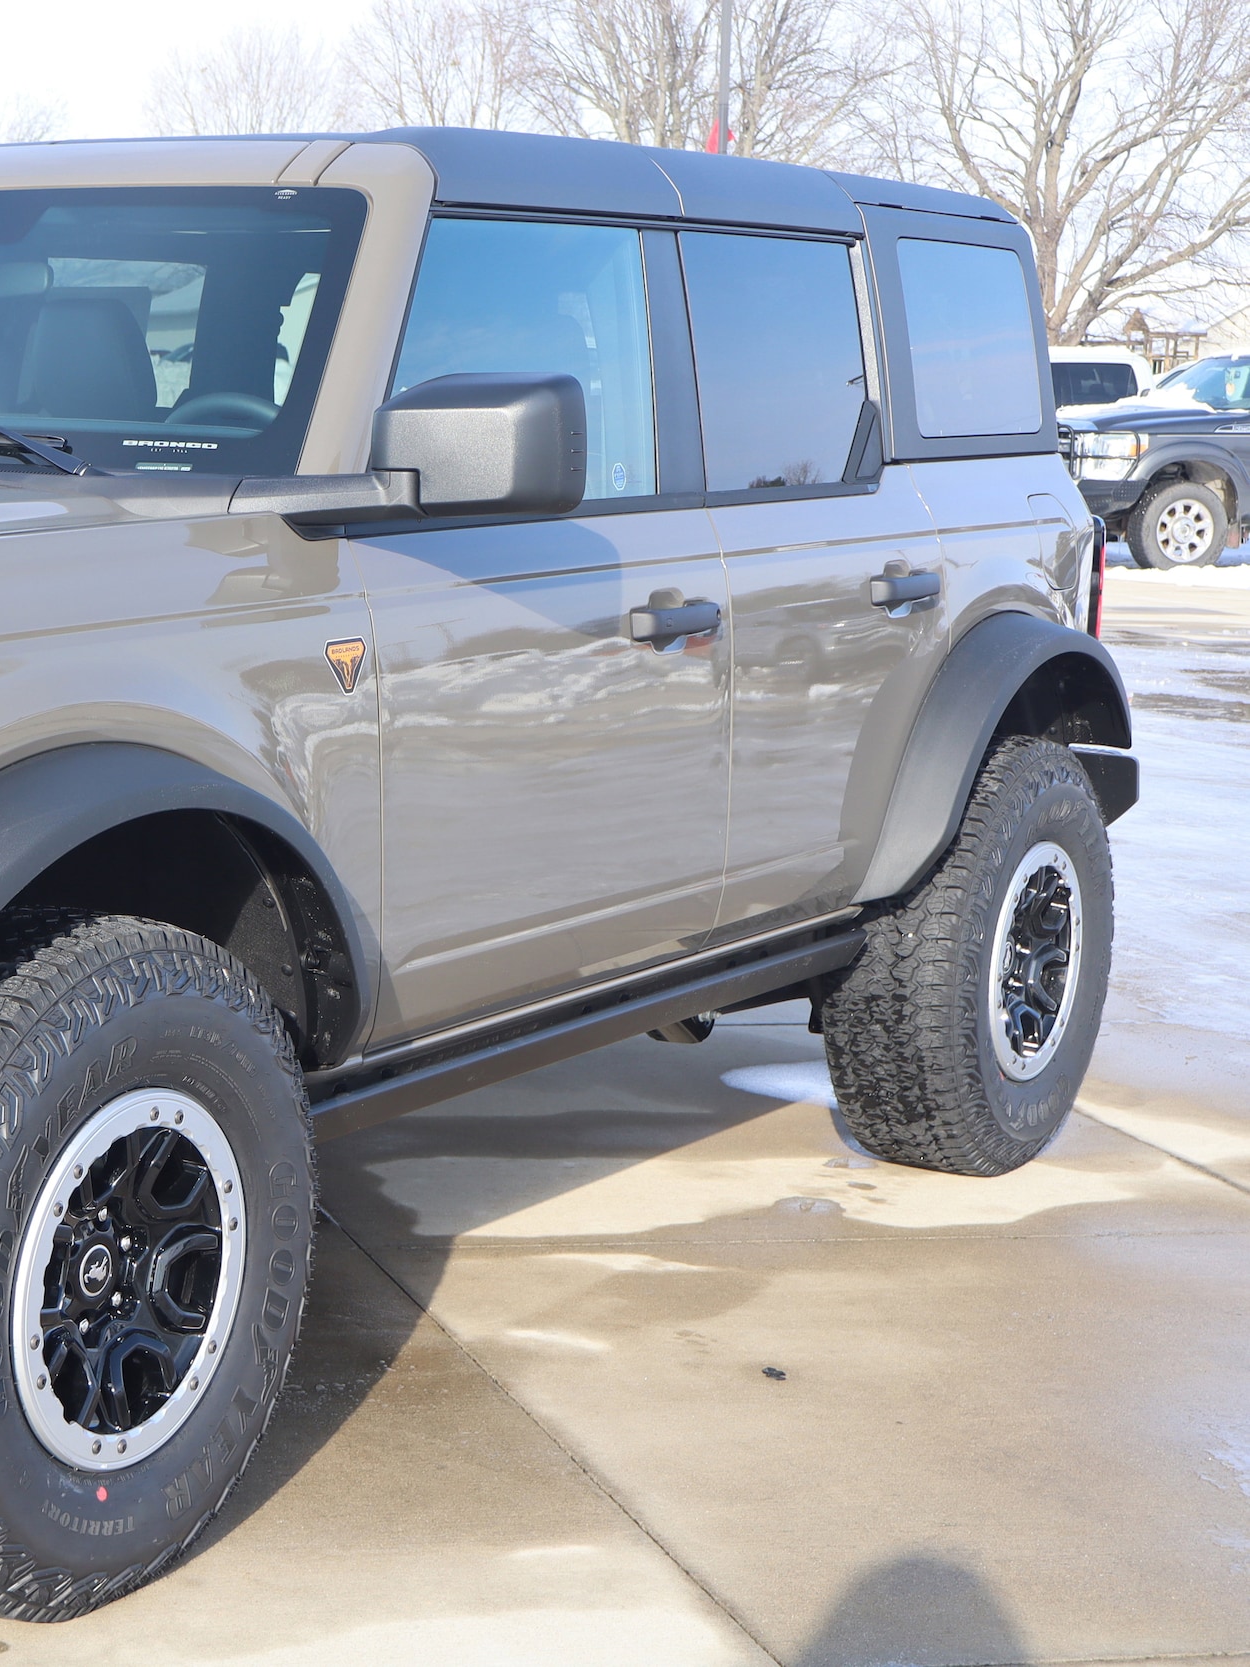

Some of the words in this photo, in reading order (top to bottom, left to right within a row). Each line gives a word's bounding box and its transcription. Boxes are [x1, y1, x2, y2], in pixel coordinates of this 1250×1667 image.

[122, 440, 218, 449] BRONCO
[134, 1159, 300, 1521] GOODYEAR
[40, 1499, 136, 1536] TERRITORY
